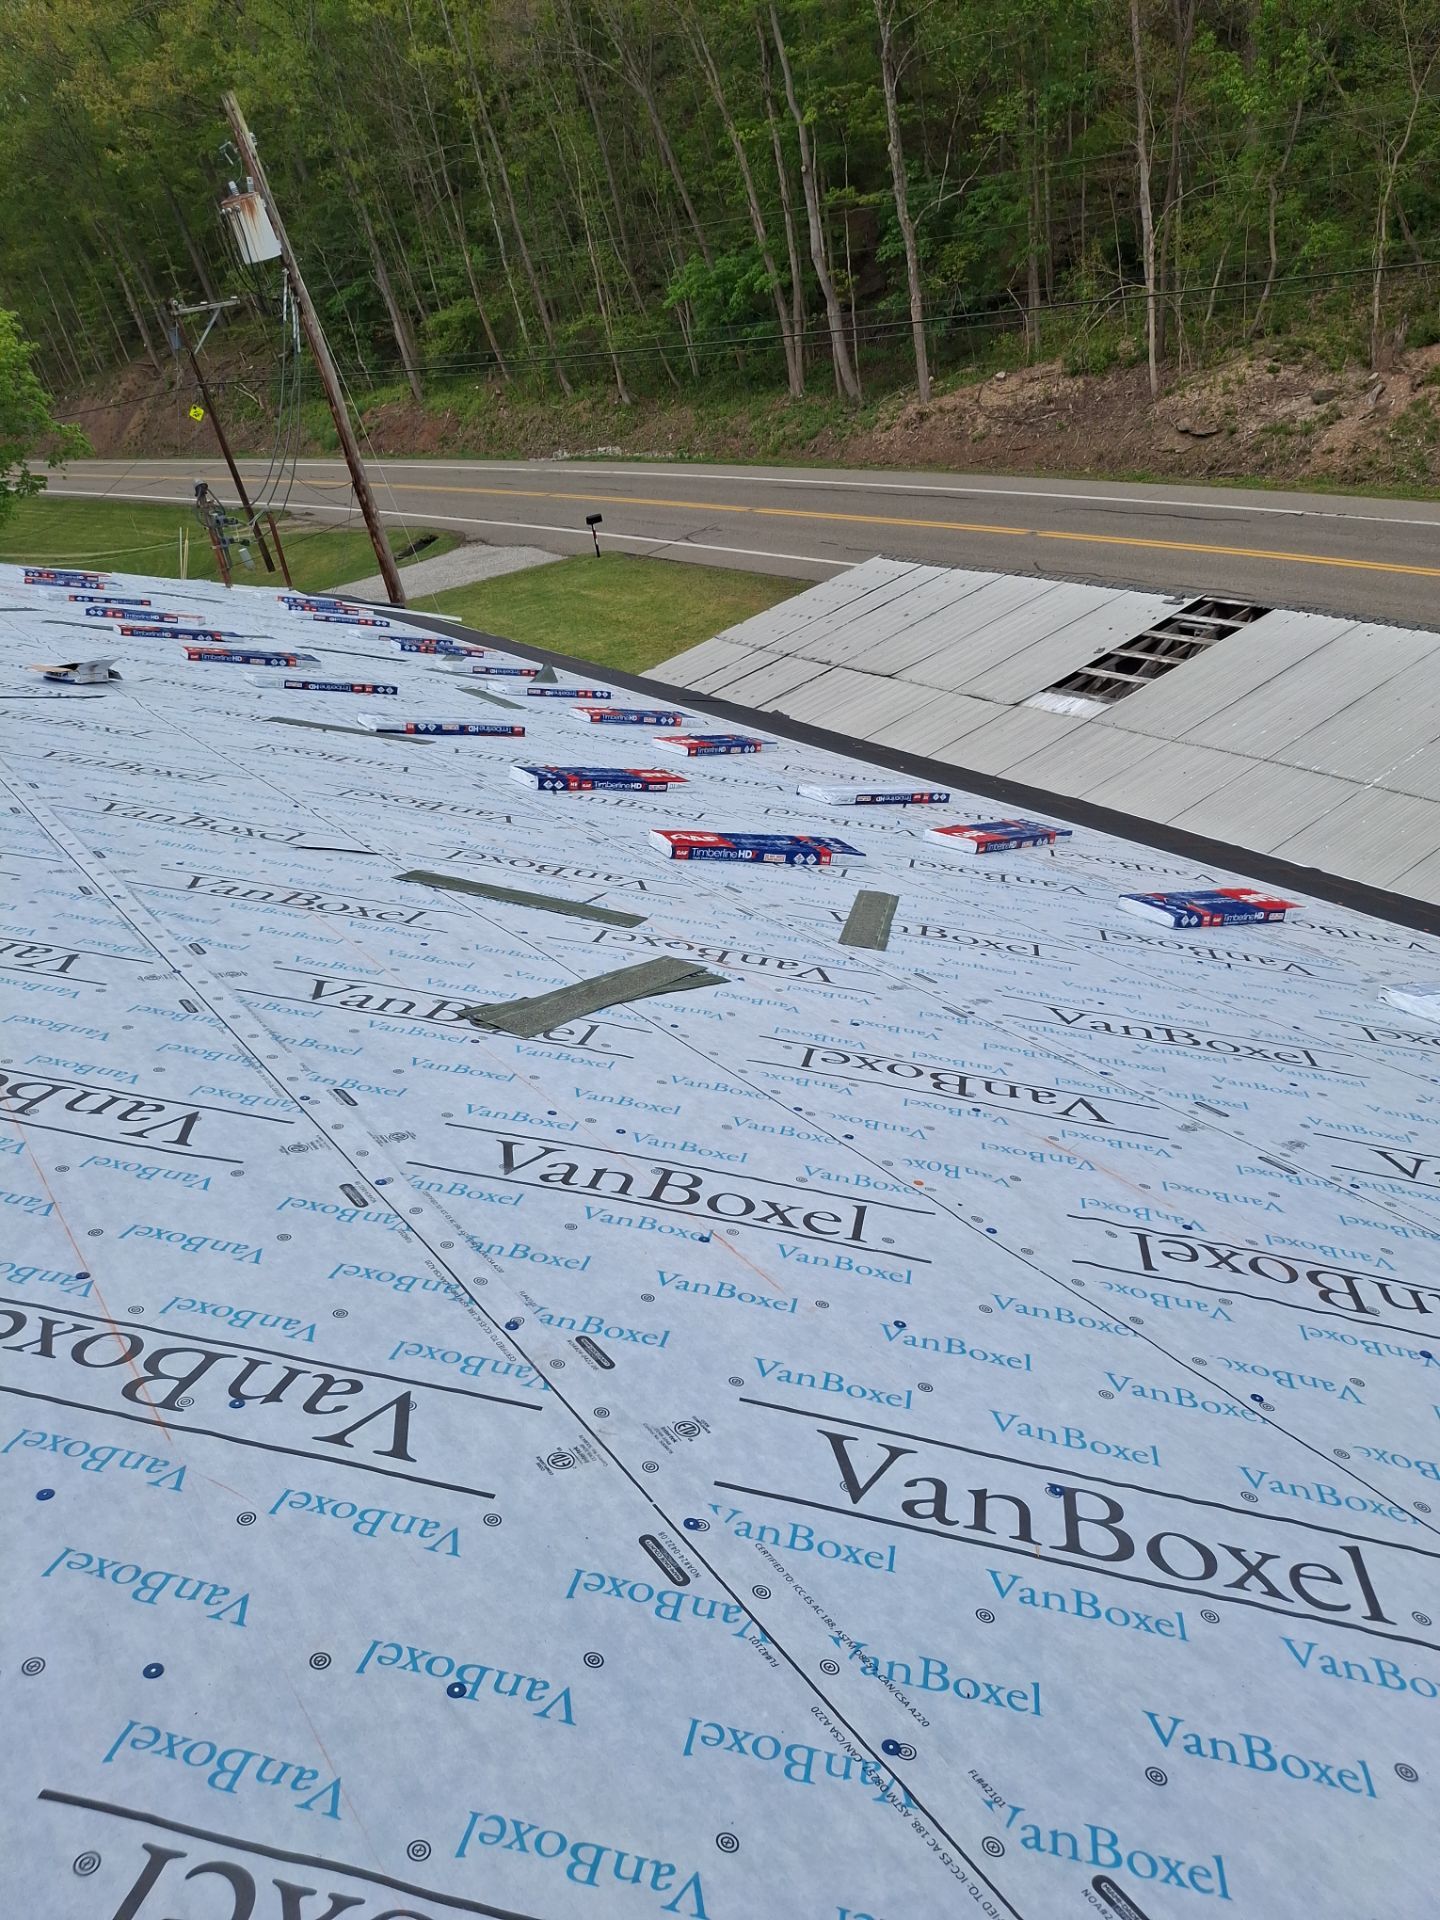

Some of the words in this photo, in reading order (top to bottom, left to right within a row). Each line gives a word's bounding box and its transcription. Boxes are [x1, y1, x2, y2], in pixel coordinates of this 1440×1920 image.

[101, 801, 306, 843] VanBoxel
[186, 874, 428, 924] VanBoxel
[593, 928, 836, 984] VanBoxel
[2, 1014, 110, 1041] VanBoxel
[367, 1019, 468, 1044] VanBoxel
[1042, 1004, 1323, 1069] VanBoxel
[25, 1055, 139, 1085] VanBoxel
[409, 1056, 518, 1083] VanBoxel
[514, 1043, 615, 1071] VanBoxel
[573, 1086, 682, 1117] VanBoxel
[801, 1046, 1116, 1126] VanBoxel
[465, 1102, 579, 1133] VanBoxel
[630, 1130, 748, 1164] VanBoxel
[980, 1140, 1098, 1173] VanBoxel
[1061, 1127, 1173, 1159] VanBoxel
[80, 1156, 212, 1191] VanBoxel
[495, 1138, 869, 1244] VanBoxel
[1079, 1197, 1206, 1233] VanBoxel
[1160, 1180, 1283, 1214] VanBoxel
[119, 1224, 264, 1265] VanBoxel
[584, 1204, 713, 1244] VanBoxel
[779, 1245, 912, 1285] VanBoxel
[1265, 1234, 1396, 1271] VanBoxel
[659, 1271, 797, 1313] VanBoxel
[160, 1298, 316, 1343] VanBoxel
[389, 1342, 550, 1391] VanBoxel
[882, 1322, 1031, 1372] VanBoxel
[756, 1358, 912, 1410] VanBoxel
[2, 1429, 186, 1494] VanBoxel
[992, 1411, 1159, 1467] VanBoxel
[268, 1490, 460, 1557] VanBoxel
[817, 1428, 1398, 1626] VanBoxel
[42, 1548, 249, 1628] VanBoxel
[566, 1570, 769, 1645] VanBoxel
[988, 1570, 1189, 1644] VanBoxel
[356, 1641, 575, 1727] VanBoxel
[102, 1721, 341, 1822] VanBoxel
[1145, 1712, 1376, 1799] VanBoxel
[454, 1811, 710, 1919] VanBoxel
